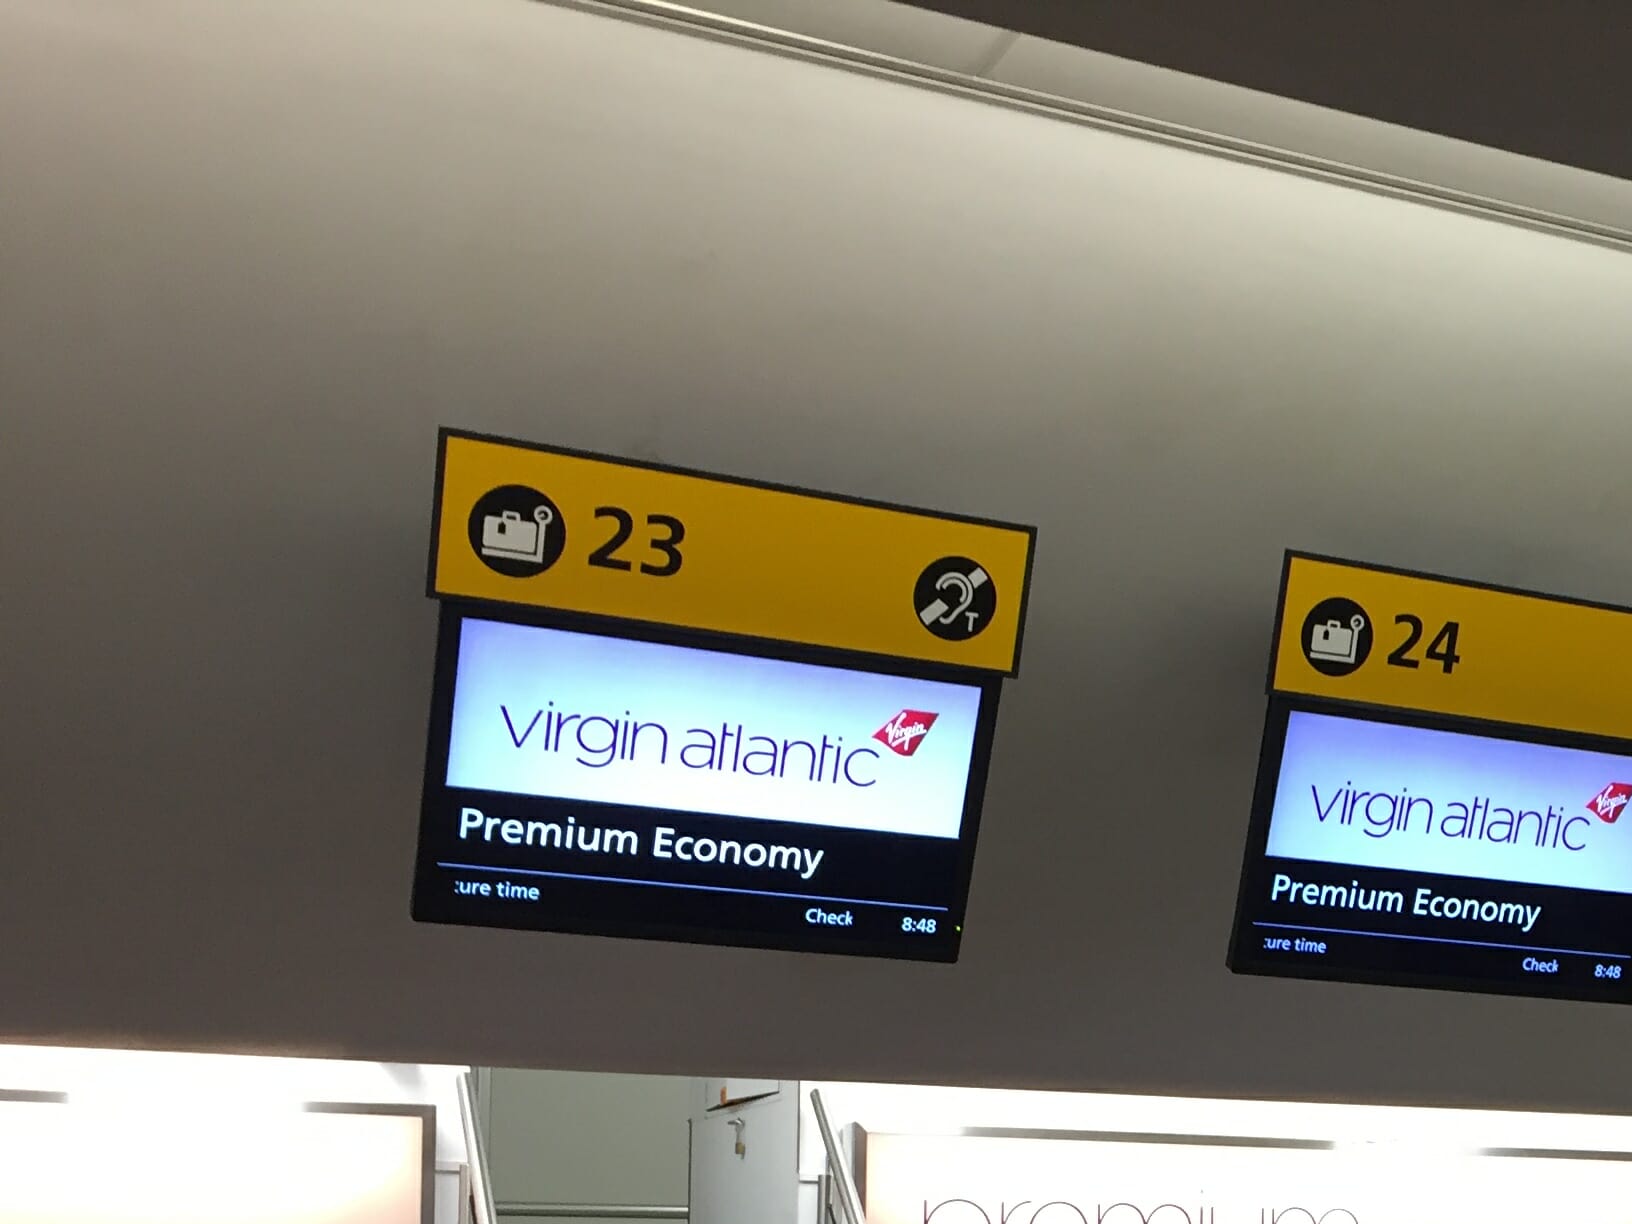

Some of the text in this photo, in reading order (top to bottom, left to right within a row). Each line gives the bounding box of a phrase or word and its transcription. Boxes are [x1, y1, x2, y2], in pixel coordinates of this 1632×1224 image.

[588, 506, 685, 577] 23
[1387, 613, 1461, 675] 24
[499, 700, 882, 788] virgin atlantic
[885, 711, 928, 751] Virgin
[1310, 779, 1591, 852] virgin atlantic
[1596, 785, 1627, 819] Virgin
[459, 807, 824, 880] Premium Economy
[495, 879, 541, 900] time
[1270, 873, 1542, 933] Premium Economy
[804, 907, 854, 927] Check
[902, 917, 938, 935] 8:48
[1293, 937, 1327, 954] time
[1522, 956, 1559, 974] Check
[1594, 963, 1622, 980] 8:48
